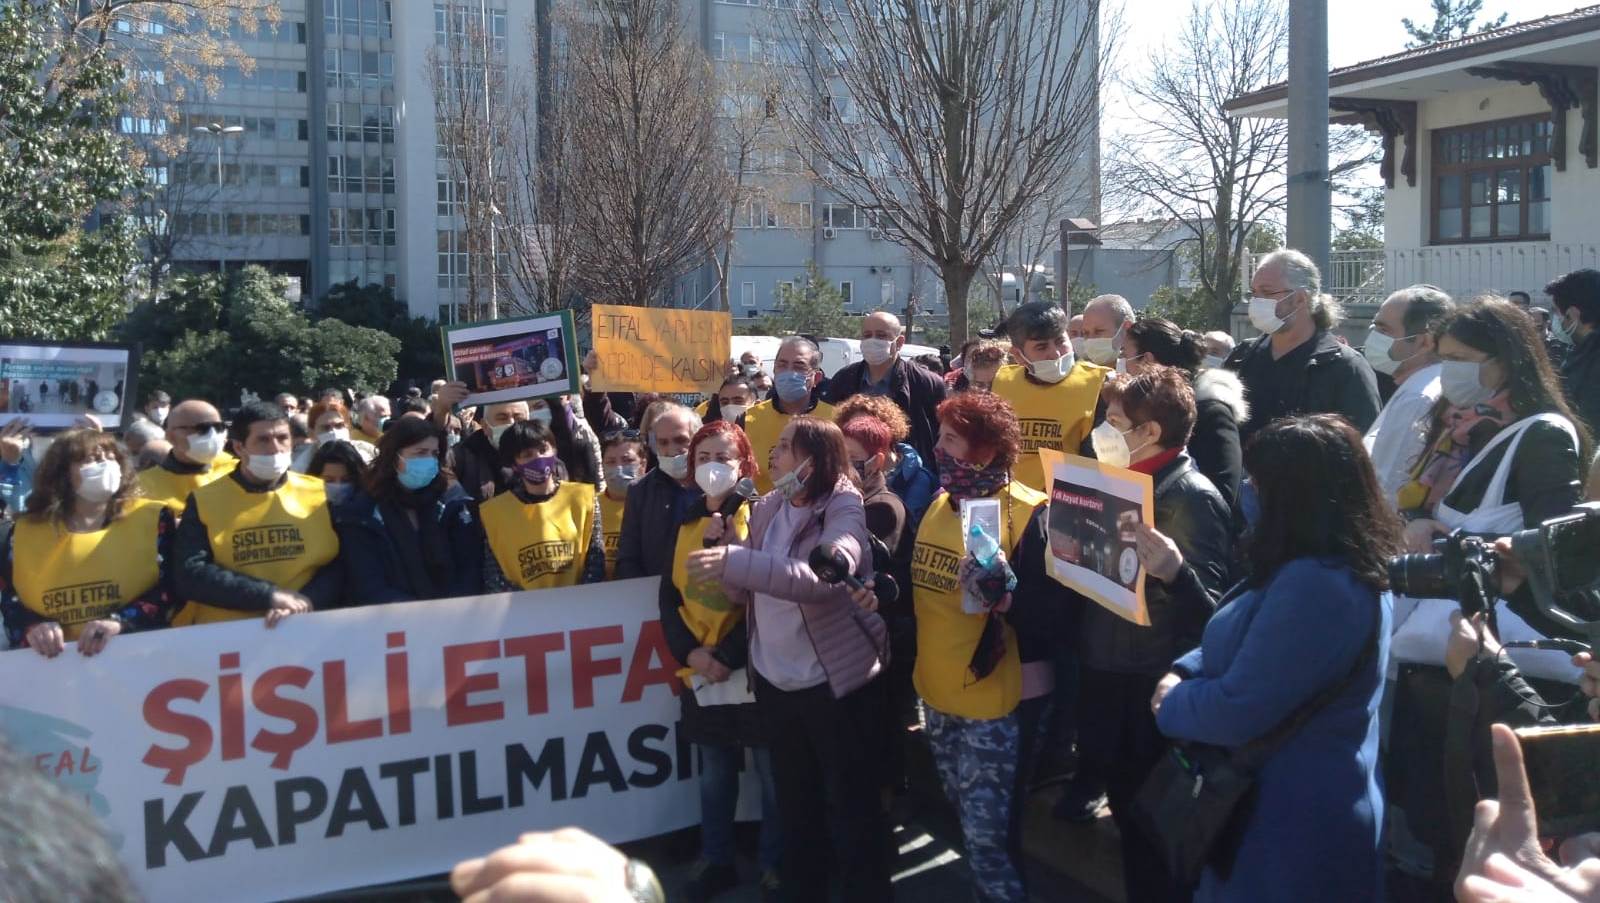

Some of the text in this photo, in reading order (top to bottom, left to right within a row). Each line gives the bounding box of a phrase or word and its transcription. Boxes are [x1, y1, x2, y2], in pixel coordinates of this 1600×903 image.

[598, 314, 648, 341] ETFAL
[1032, 422, 1062, 438] ETFAL
[268, 527, 304, 544] ETFAL
[81, 584, 122, 605] ETFAL
[141, 620, 682, 786] ŞİŞLİ ETFA
[144, 720, 703, 870] KAPATILMASI
